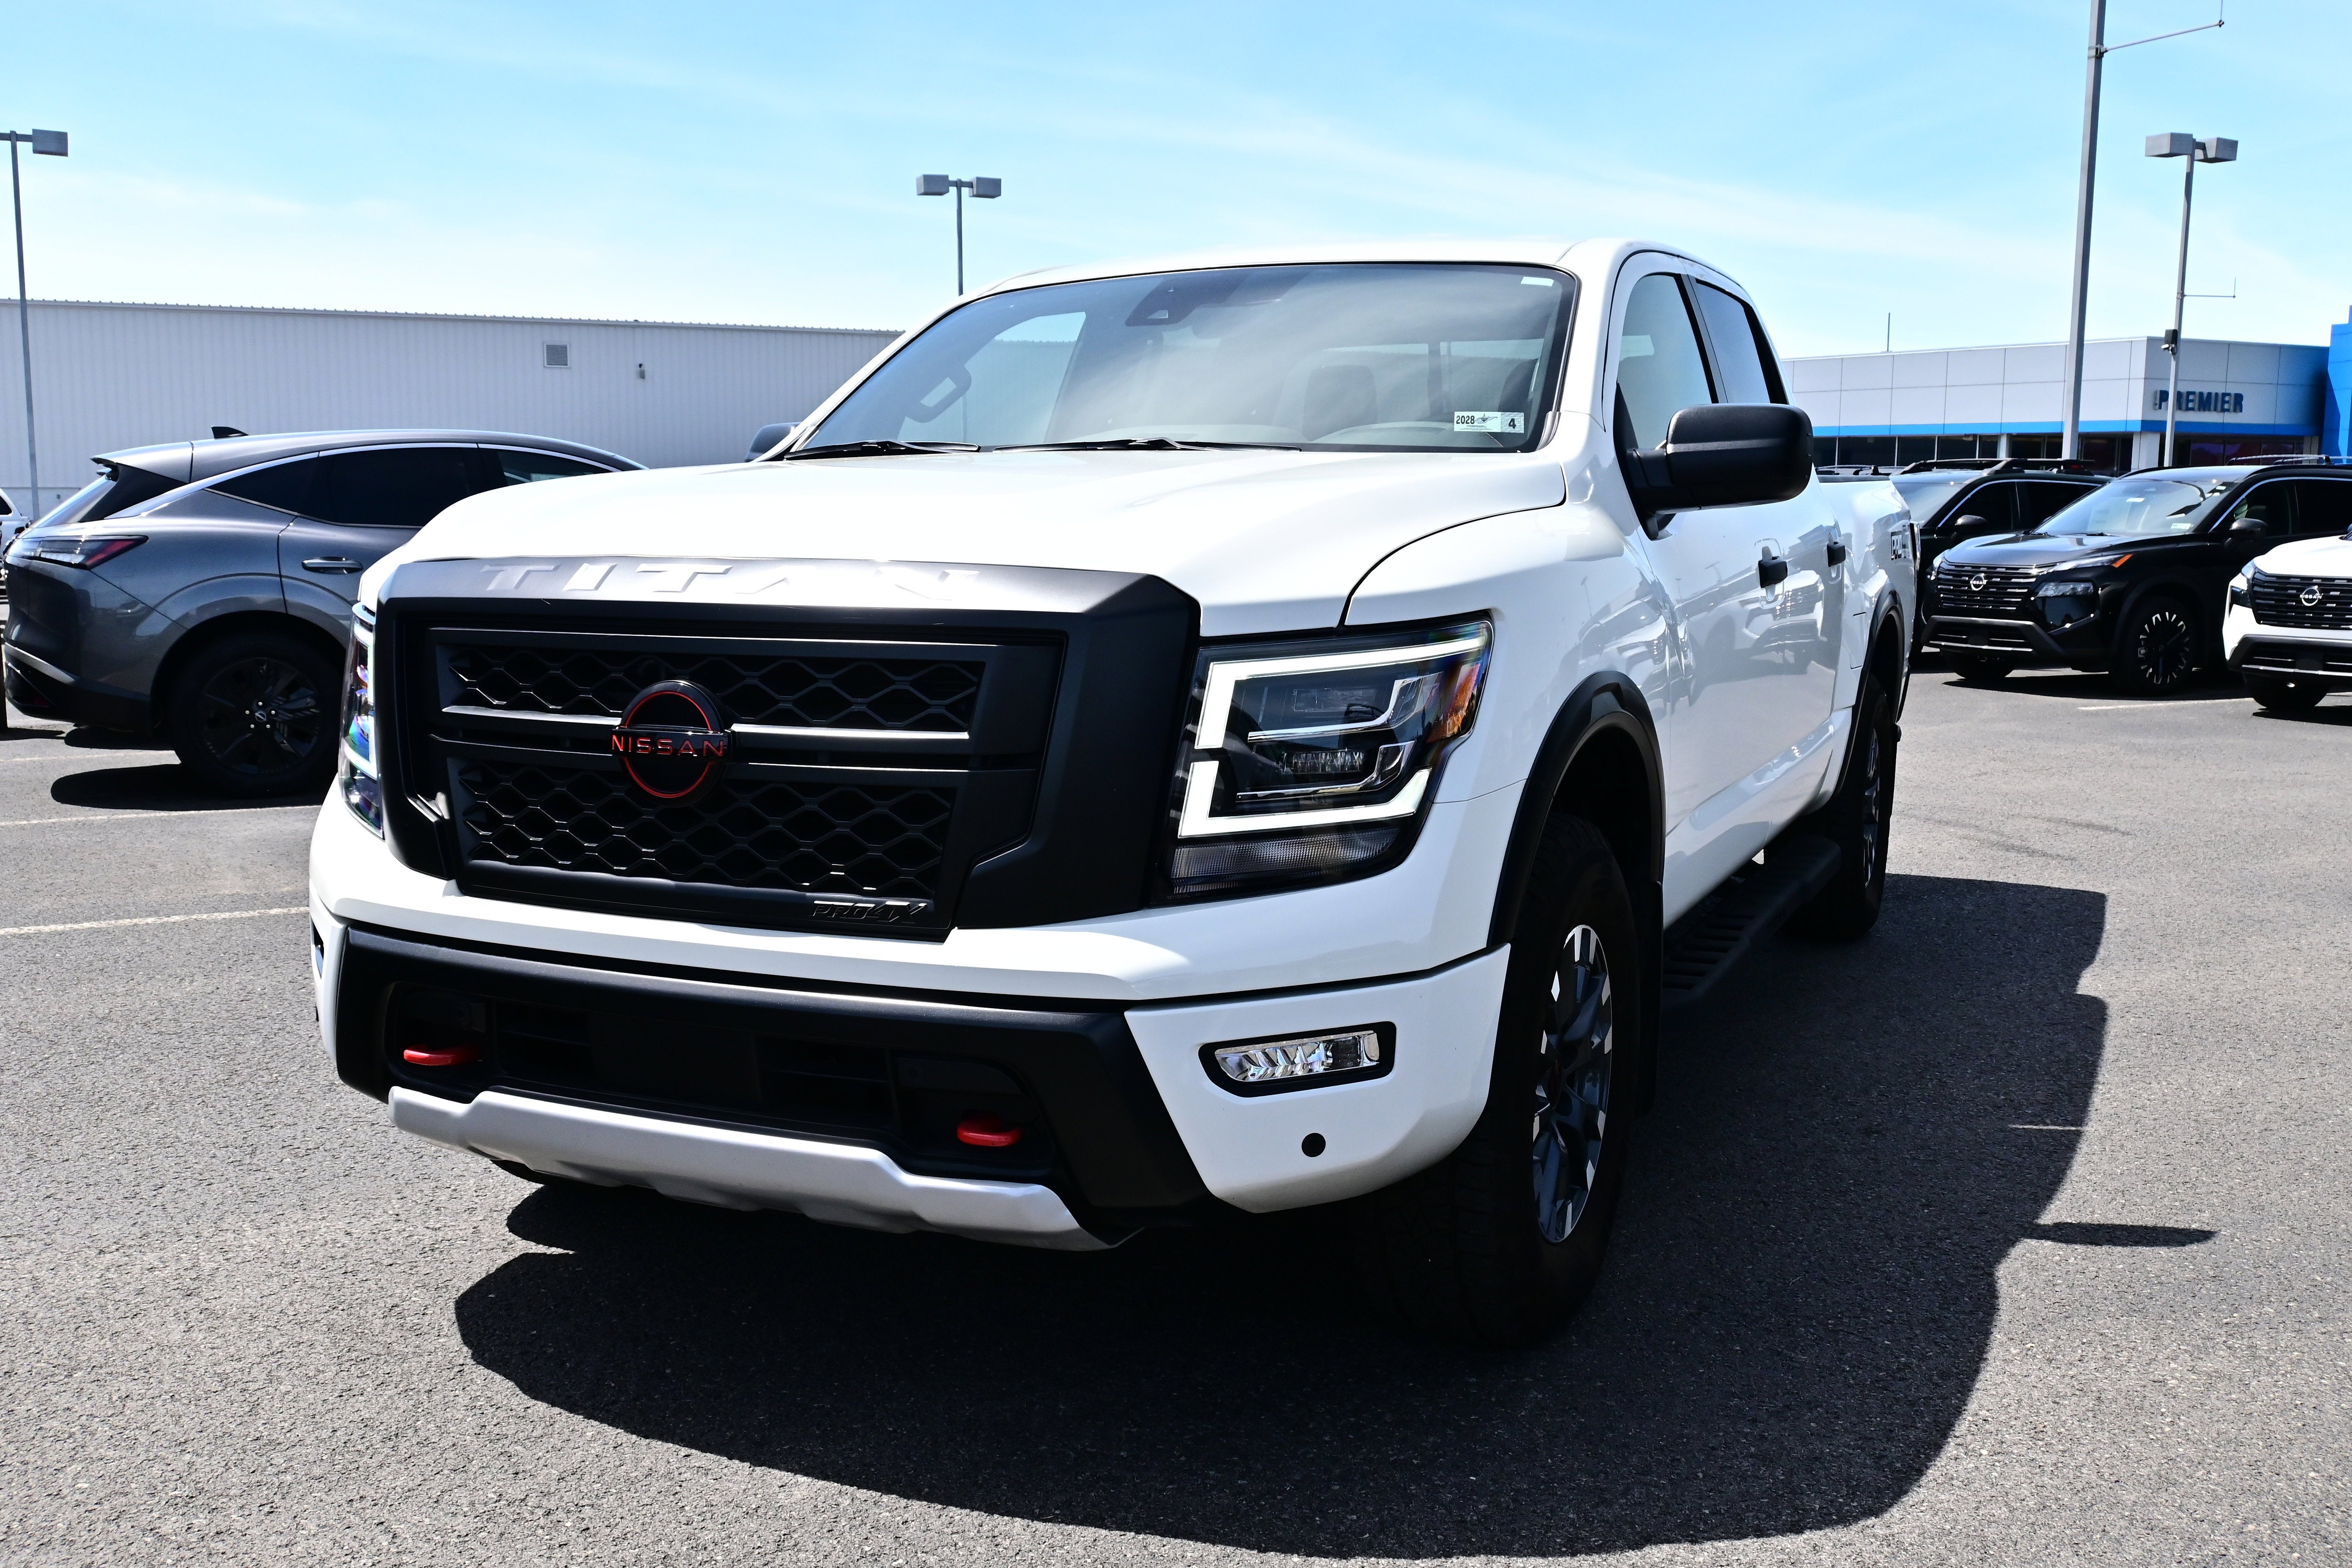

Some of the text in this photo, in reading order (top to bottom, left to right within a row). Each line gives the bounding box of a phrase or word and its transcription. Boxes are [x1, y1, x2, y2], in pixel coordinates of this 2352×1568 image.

[1456, 415, 1475, 424] 2028
[1508, 418, 1516, 429] 4
[481, 563, 980, 601] TITAN
[612, 735, 724, 757] NISSAN
